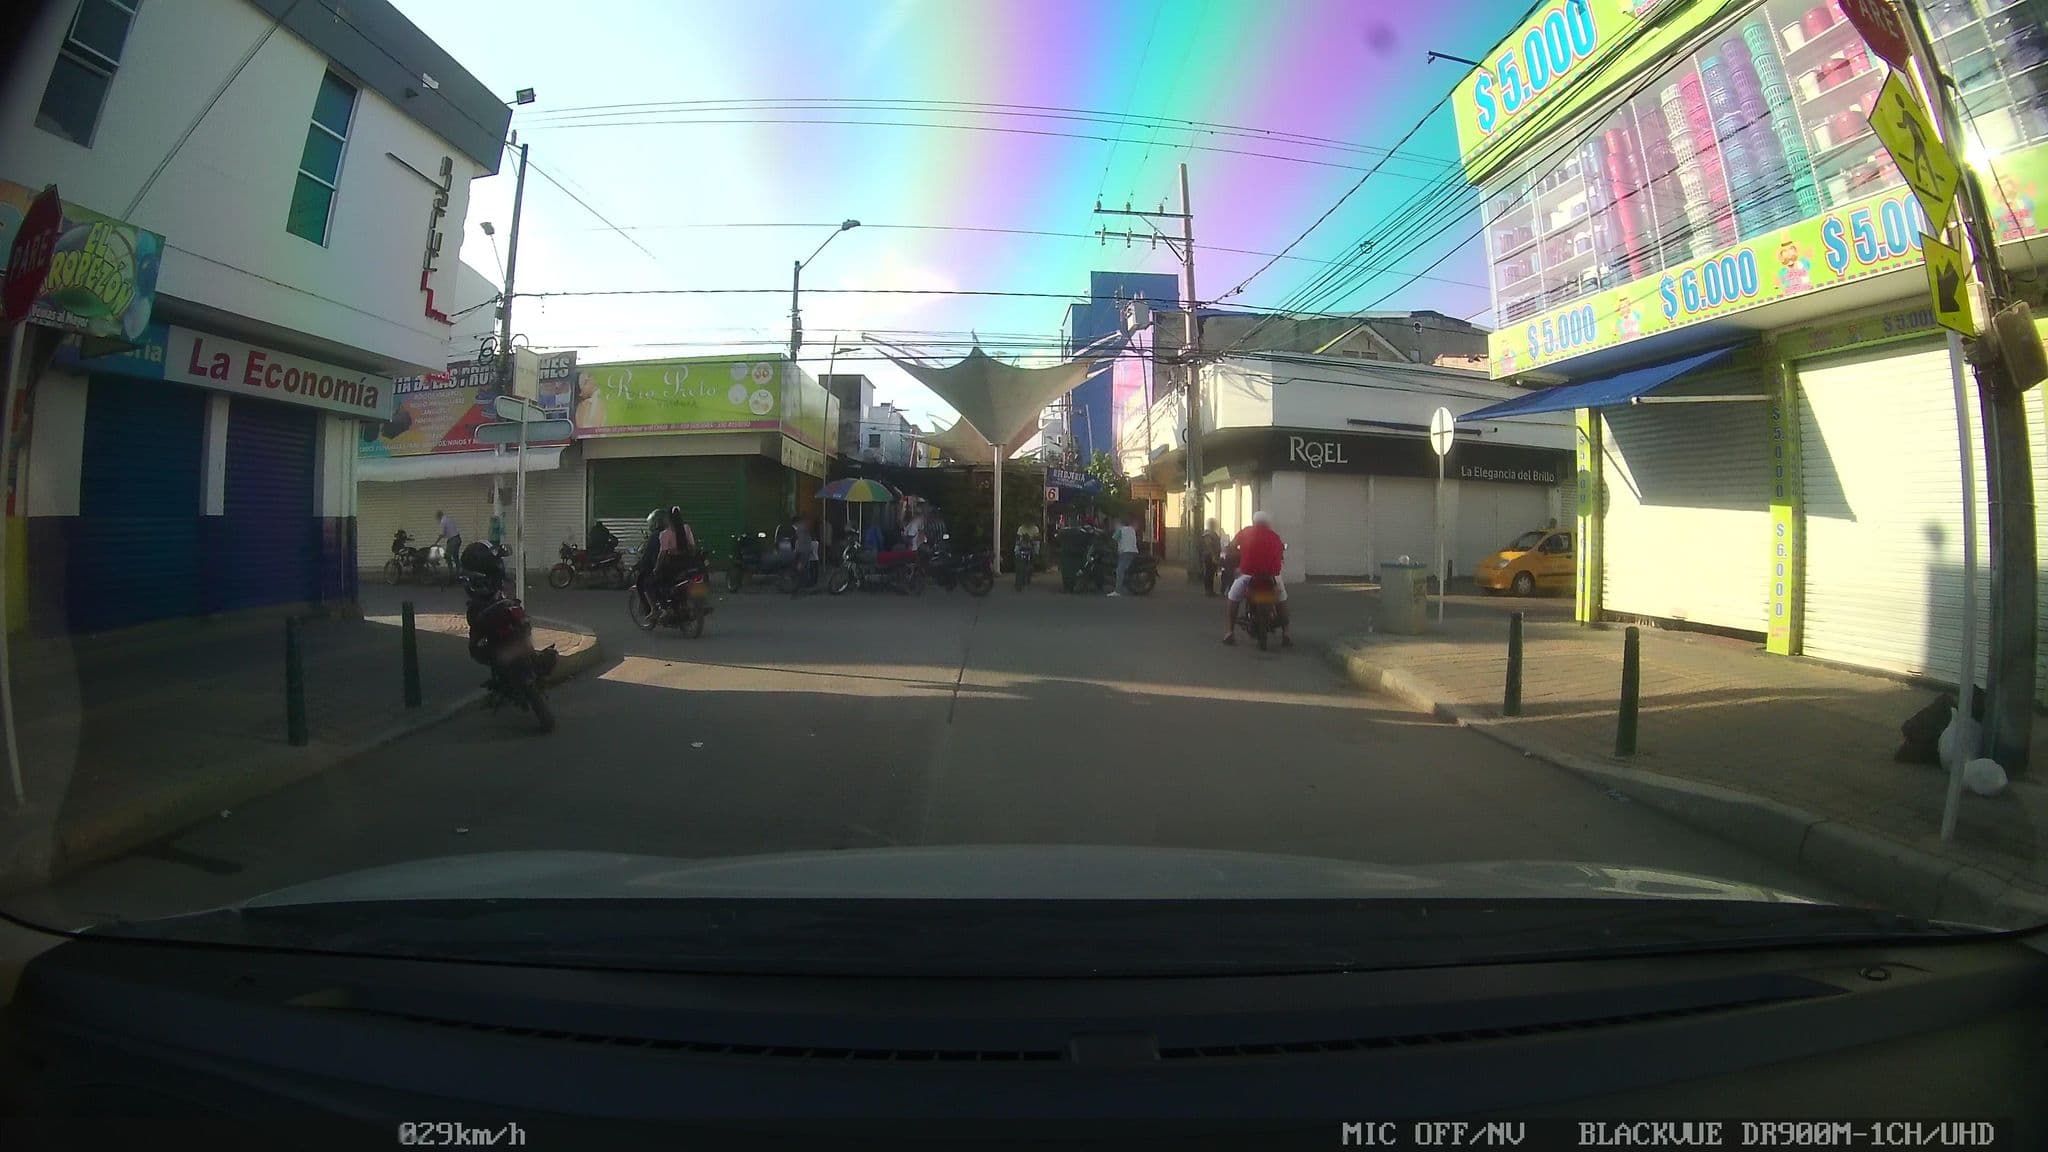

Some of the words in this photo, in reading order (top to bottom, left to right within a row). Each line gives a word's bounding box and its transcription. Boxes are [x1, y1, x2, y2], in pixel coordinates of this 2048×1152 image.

[84, 222, 112, 259] EL
[39, 250, 136, 316] ROPEZÓN
[189, 338, 231, 381] La
[243, 350, 379, 409] Economía
[1289, 436, 1348, 468] ROEL
[1461, 466, 1472, 477] La
[1474, 466, 1516, 480] Elegancia
[1518, 470, 1531, 481] del
[1533, 471, 1555, 482] Brillo
[1047, 488, 1057, 500] 6
